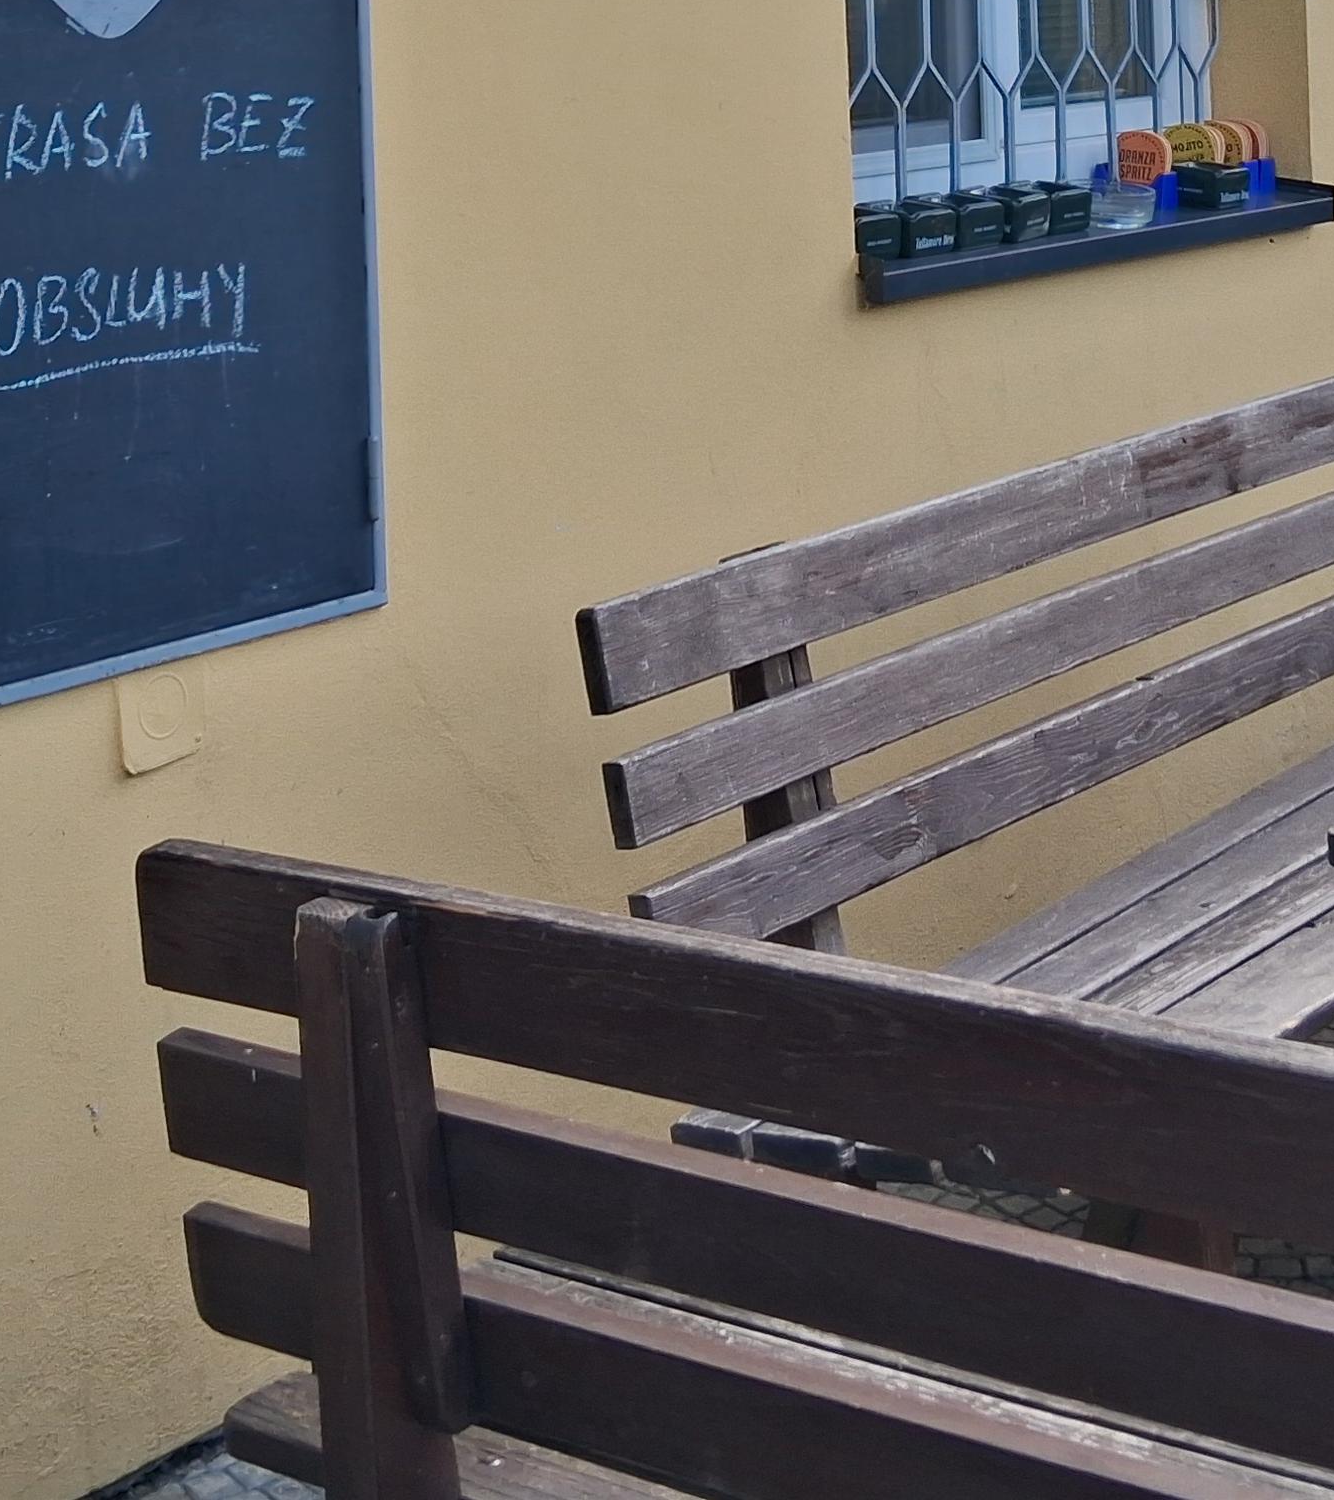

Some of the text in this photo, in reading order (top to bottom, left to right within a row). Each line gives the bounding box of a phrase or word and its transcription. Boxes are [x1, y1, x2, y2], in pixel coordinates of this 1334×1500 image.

[200, 92, 315, 161] BEZ
[1171, 140, 1204, 153] MOJITO
[1120, 164, 1153, 181] SPRITZ
